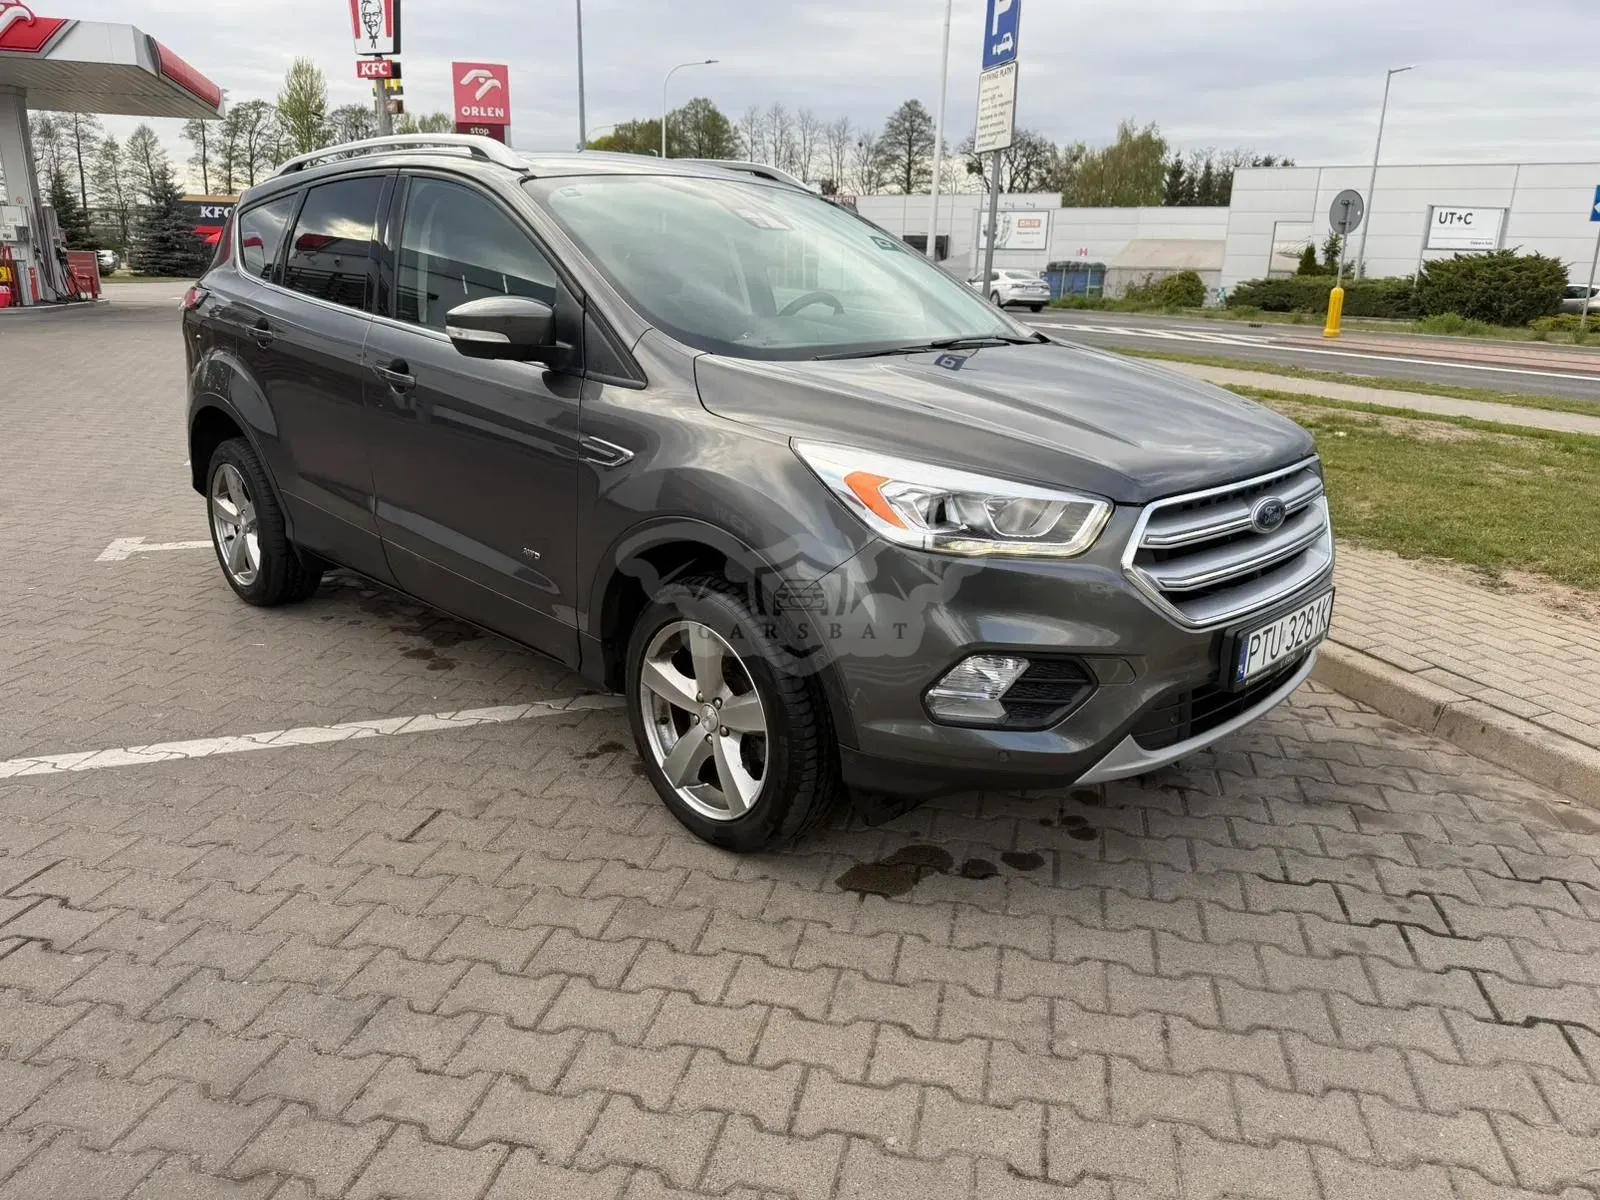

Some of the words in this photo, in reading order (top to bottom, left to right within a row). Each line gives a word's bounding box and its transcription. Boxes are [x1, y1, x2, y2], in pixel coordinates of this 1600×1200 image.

[360, 62, 388, 76] KFC
[461, 105, 505, 118] ORLEN
[470, 127, 490, 137] stop
[1438, 211, 1474, 226] UT+C
[1246, 621, 1284, 674] PTU
[1285, 594, 1332, 652] 3281K
